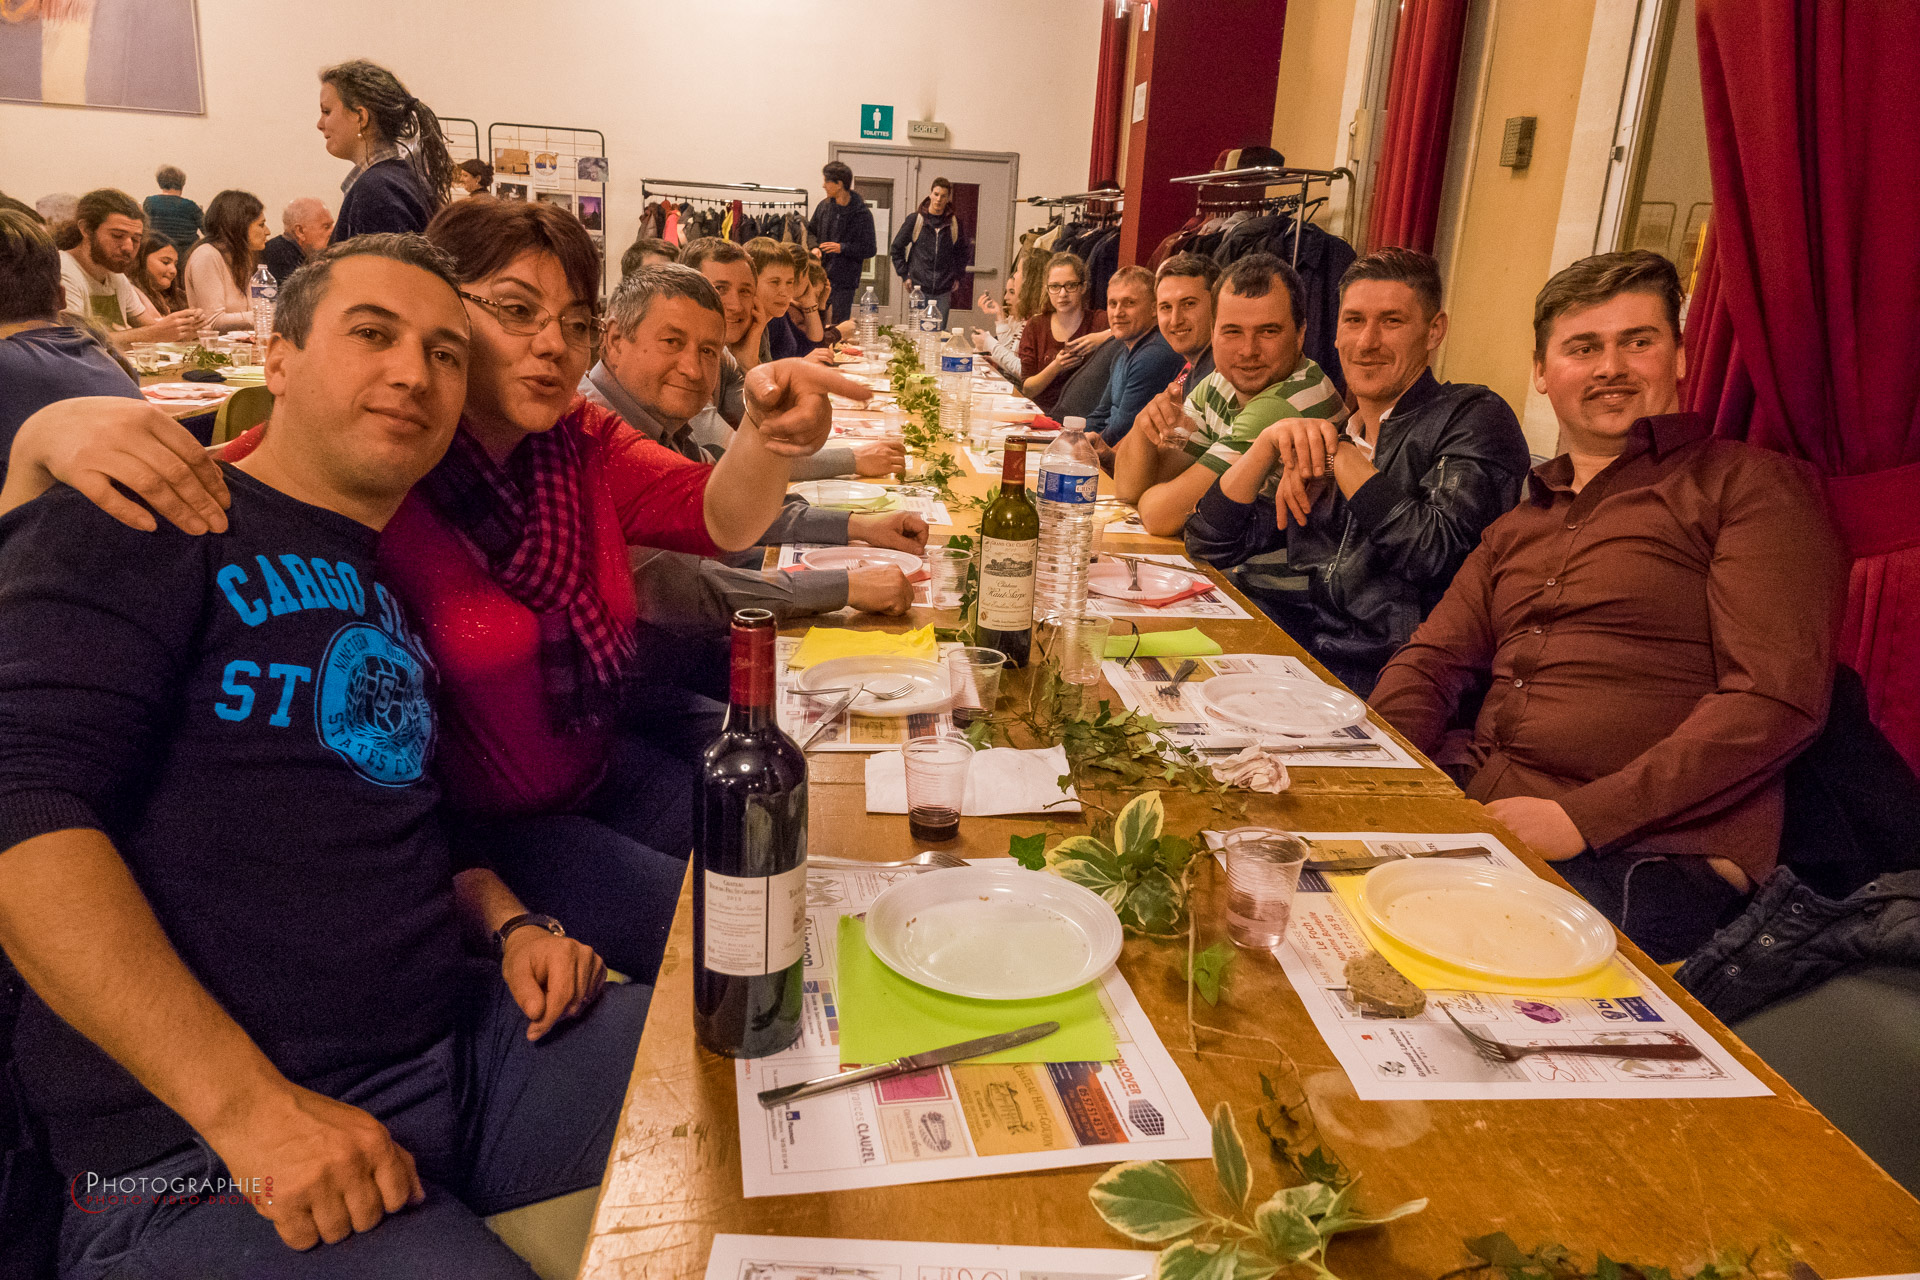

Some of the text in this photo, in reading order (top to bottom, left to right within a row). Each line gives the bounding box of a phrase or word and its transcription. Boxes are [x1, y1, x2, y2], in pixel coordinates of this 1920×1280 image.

[863, 129, 890, 138] TOILETTES
[913, 124, 938, 134] SORTIE
[217, 554, 365, 627] CARGO
[214, 659, 312, 728] ST
[329, 712, 387, 771] STATES
[1302, 922, 1328, 950] Le Foch
[1012, 1063, 1037, 1095] CHATEAU
[856, 1123, 875, 1164] CLAUZEL
